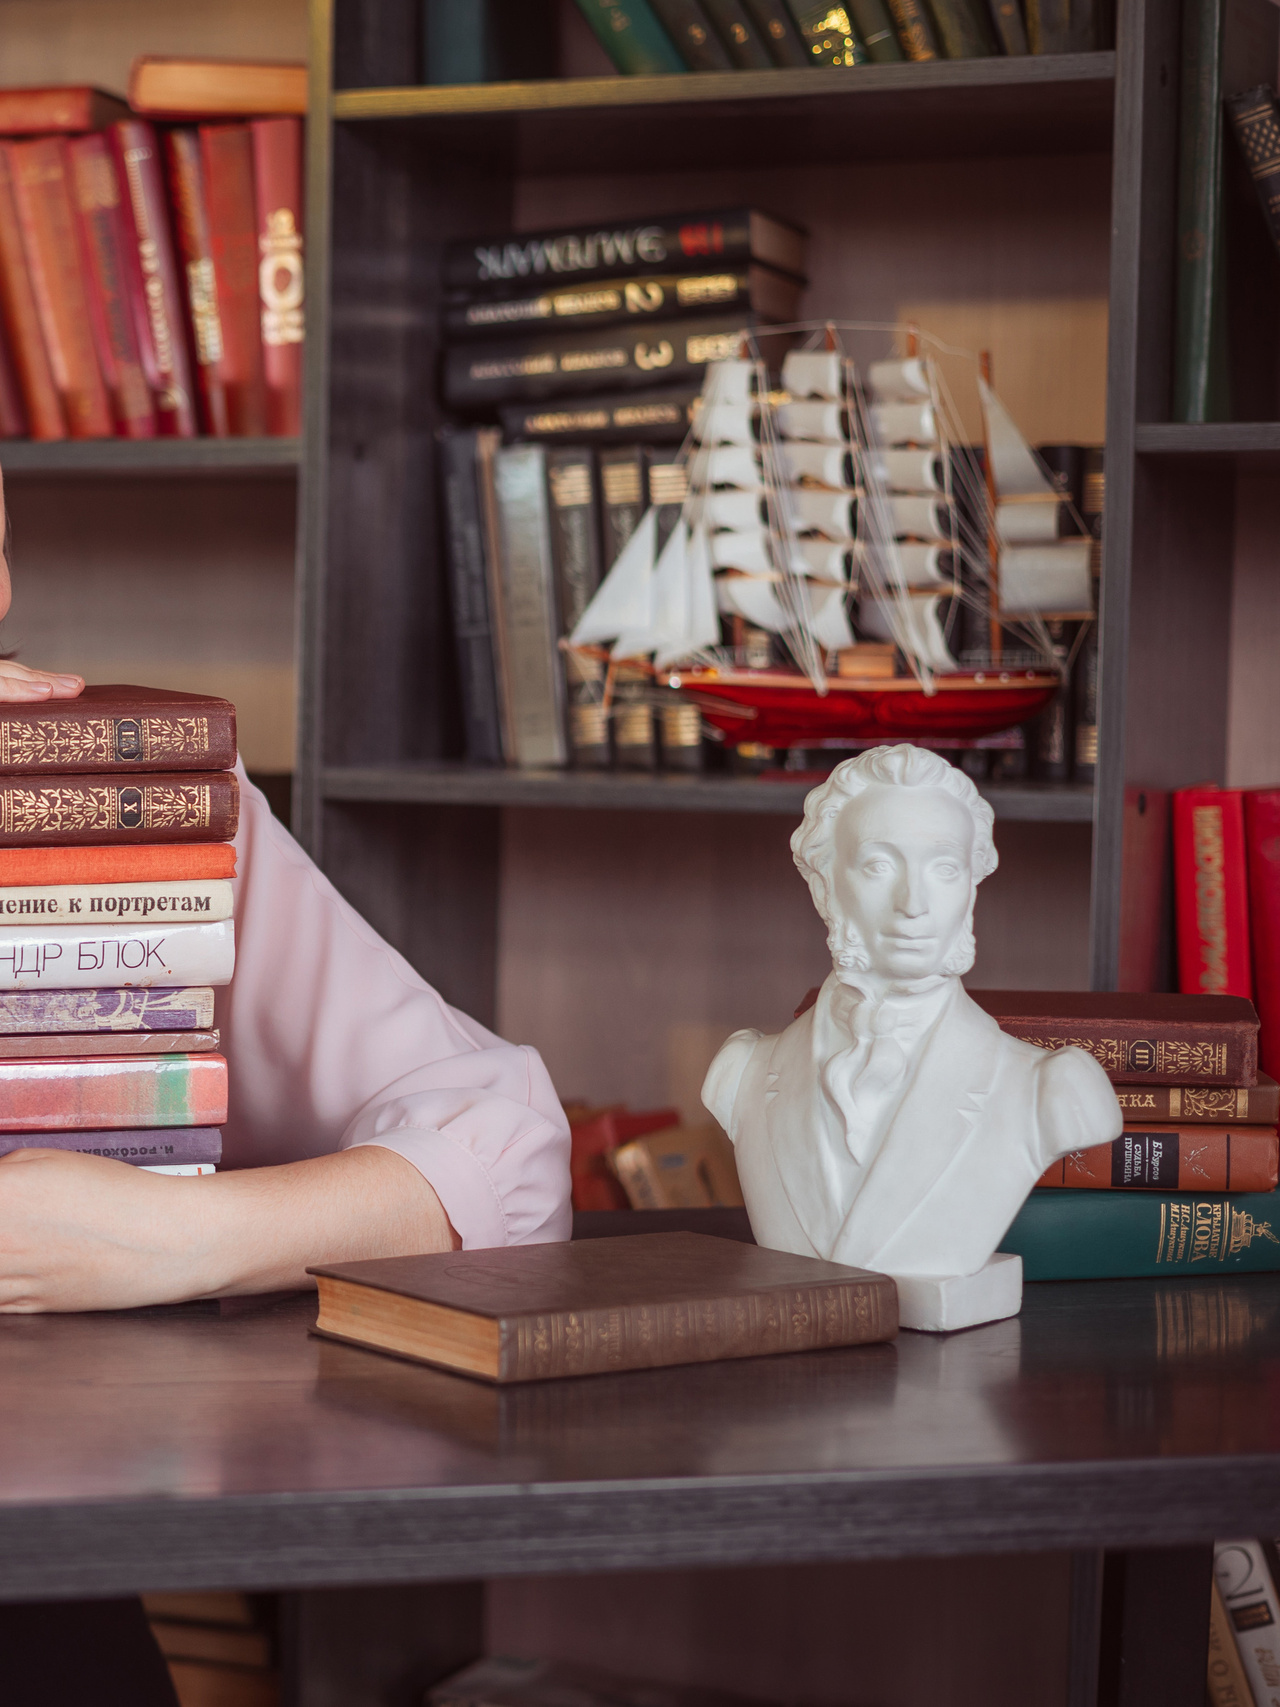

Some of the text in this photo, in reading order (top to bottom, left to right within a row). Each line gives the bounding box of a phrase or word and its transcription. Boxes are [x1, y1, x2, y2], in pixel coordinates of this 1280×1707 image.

[124, 801, 138, 814] X
[68, 898, 82, 913] к
[89, 894, 212, 918] портретам
[77, 938, 167, 971] БЛОК
[1135, 1048, 1149, 1065] III
[68, 1146, 157, 1157] РОСОХОВА
[1123, 1137, 1132, 1183] ПУШКИНА
[1133, 1143, 1142, 1177] СУДЬБА
[1151, 1140, 1162, 1180] Б.Бурсов
[1191, 1202, 1212, 1263] СЛОВА
[1209, 1203, 1222, 1258] КРЫЛАТЫЕ
